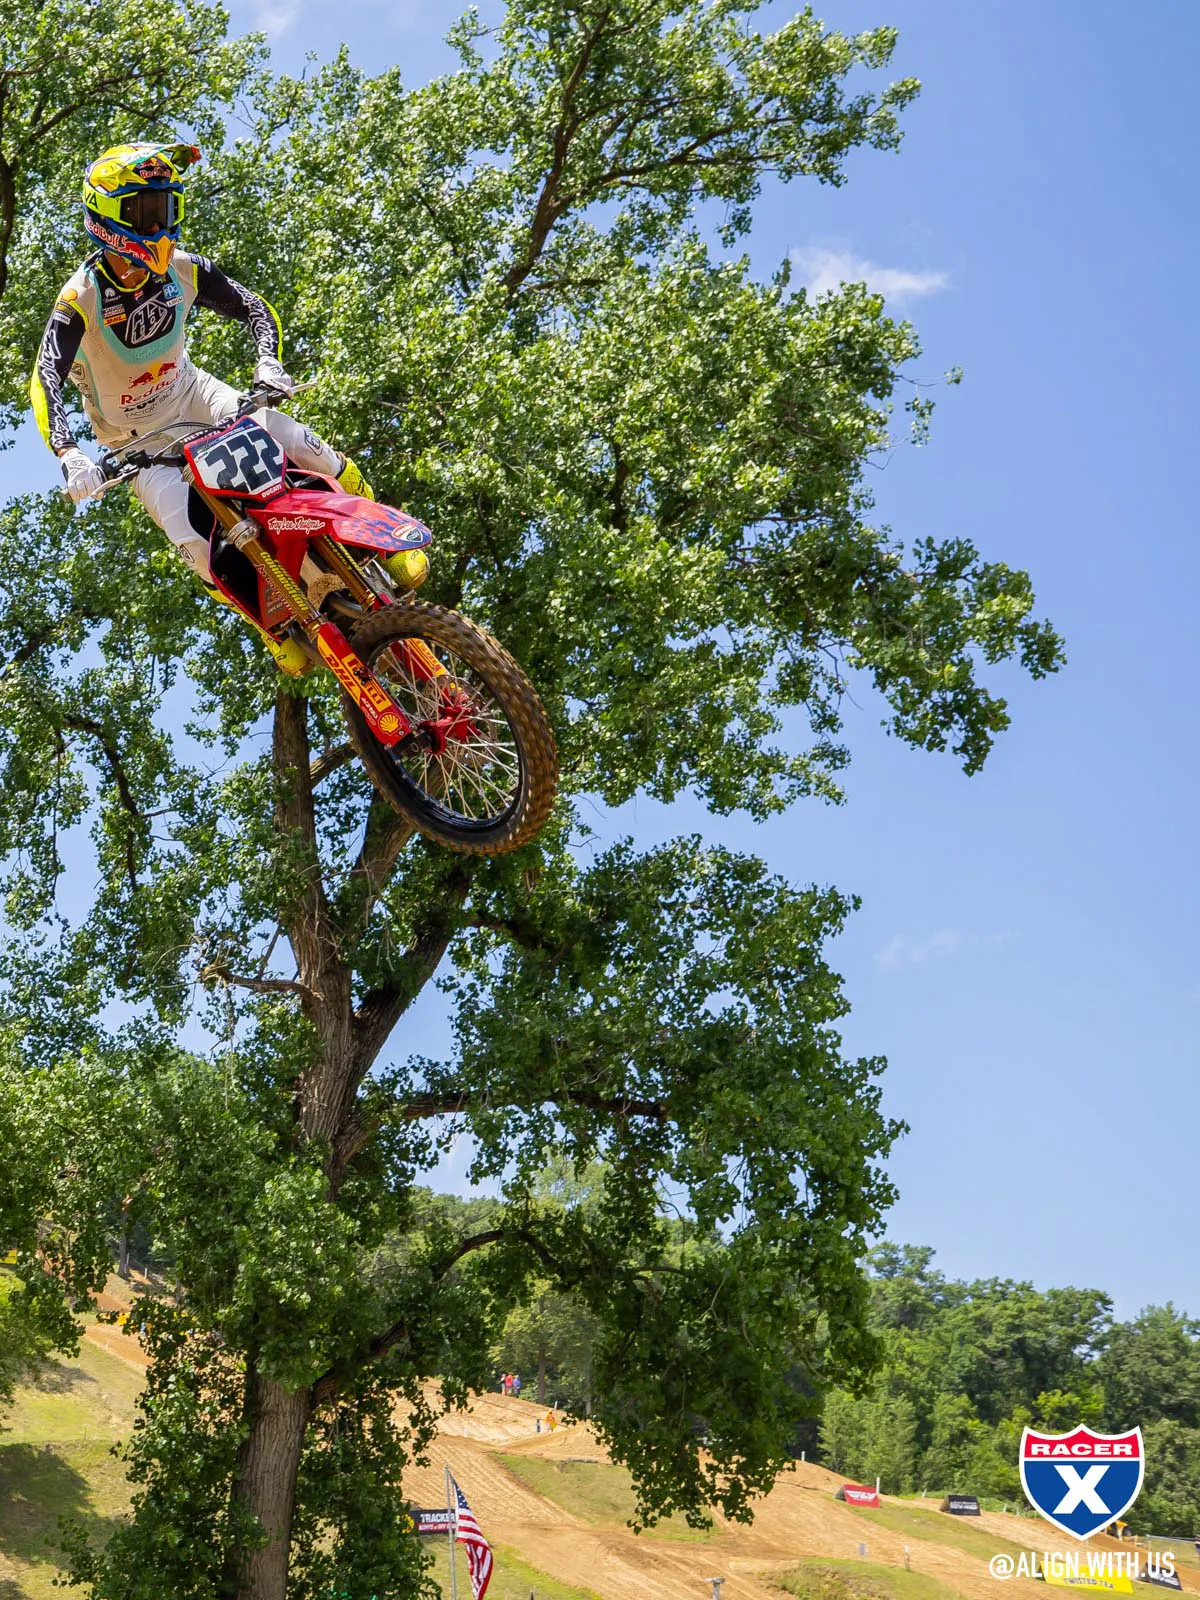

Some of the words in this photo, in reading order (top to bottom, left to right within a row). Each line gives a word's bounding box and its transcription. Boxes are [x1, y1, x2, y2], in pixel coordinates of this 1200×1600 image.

[204, 427, 282, 493] 222
[261, 484, 282, 498] DUCATI
[324, 653, 358, 692] DHL
